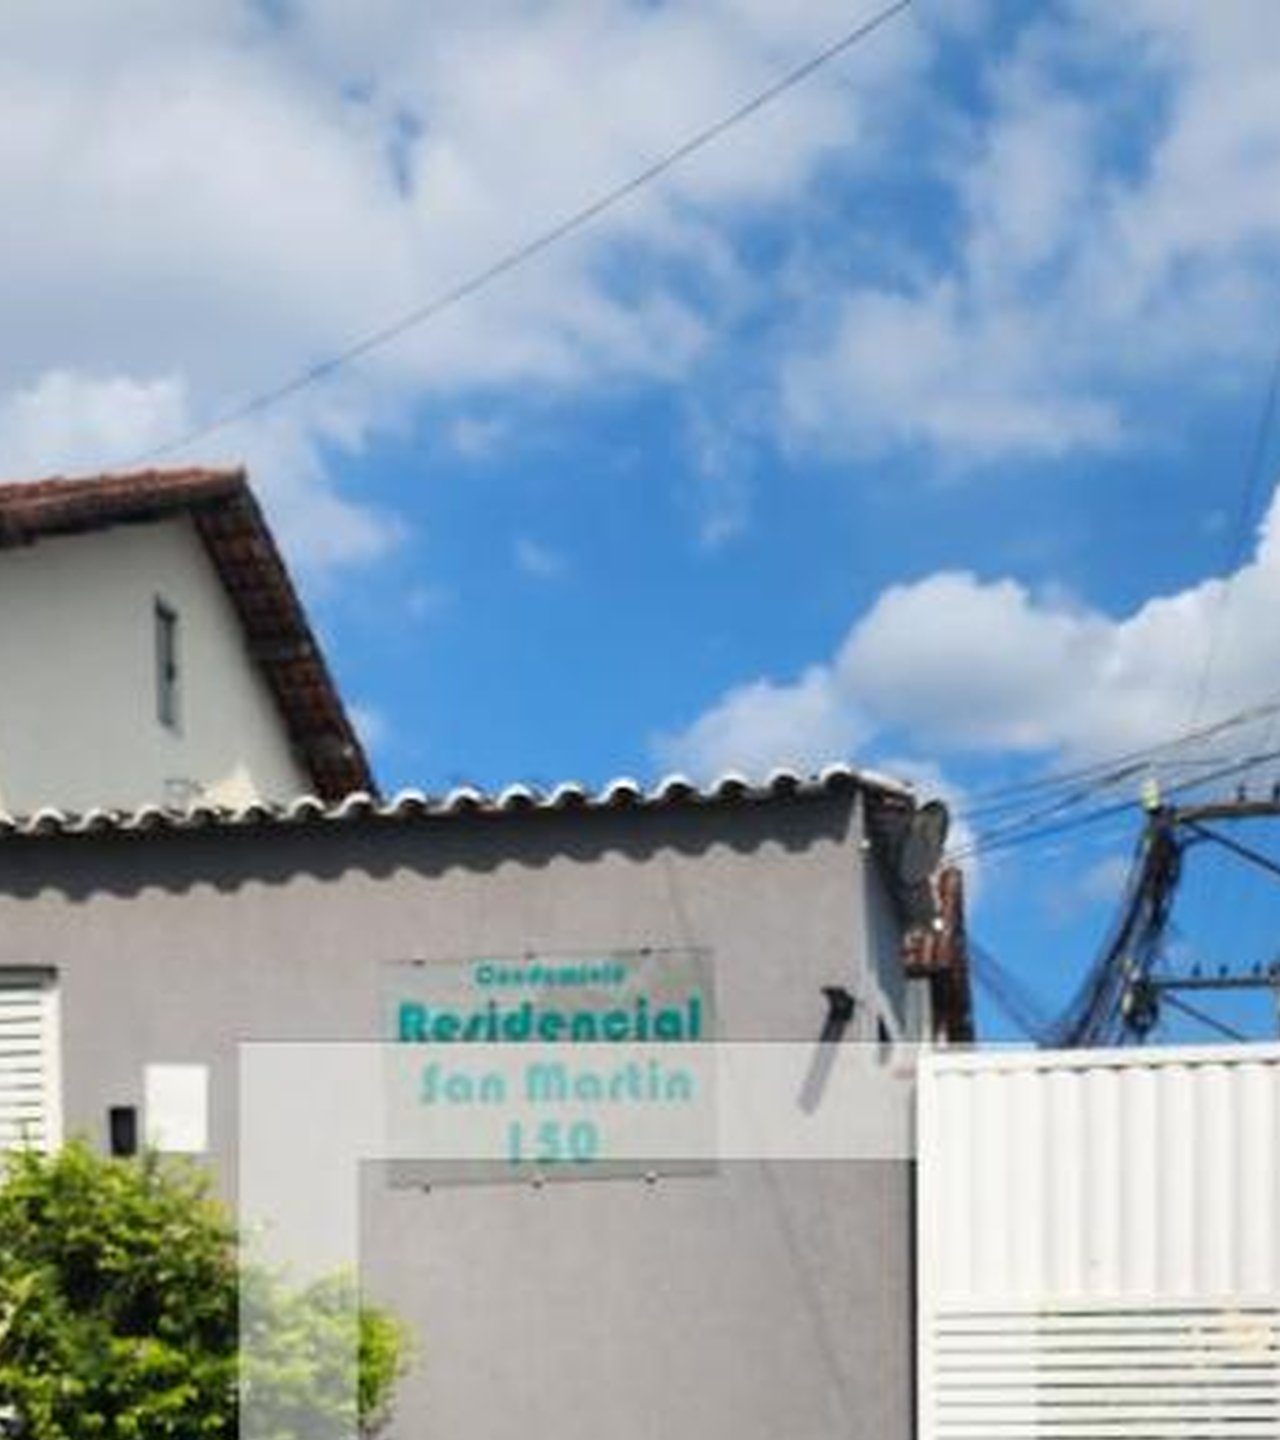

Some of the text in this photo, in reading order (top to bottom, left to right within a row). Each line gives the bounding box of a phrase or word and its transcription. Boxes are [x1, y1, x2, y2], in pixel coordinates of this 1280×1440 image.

[398, 993, 702, 1042] Residencial
[418, 1059, 694, 1104] San Martin
[507, 1120, 600, 1165] 150
